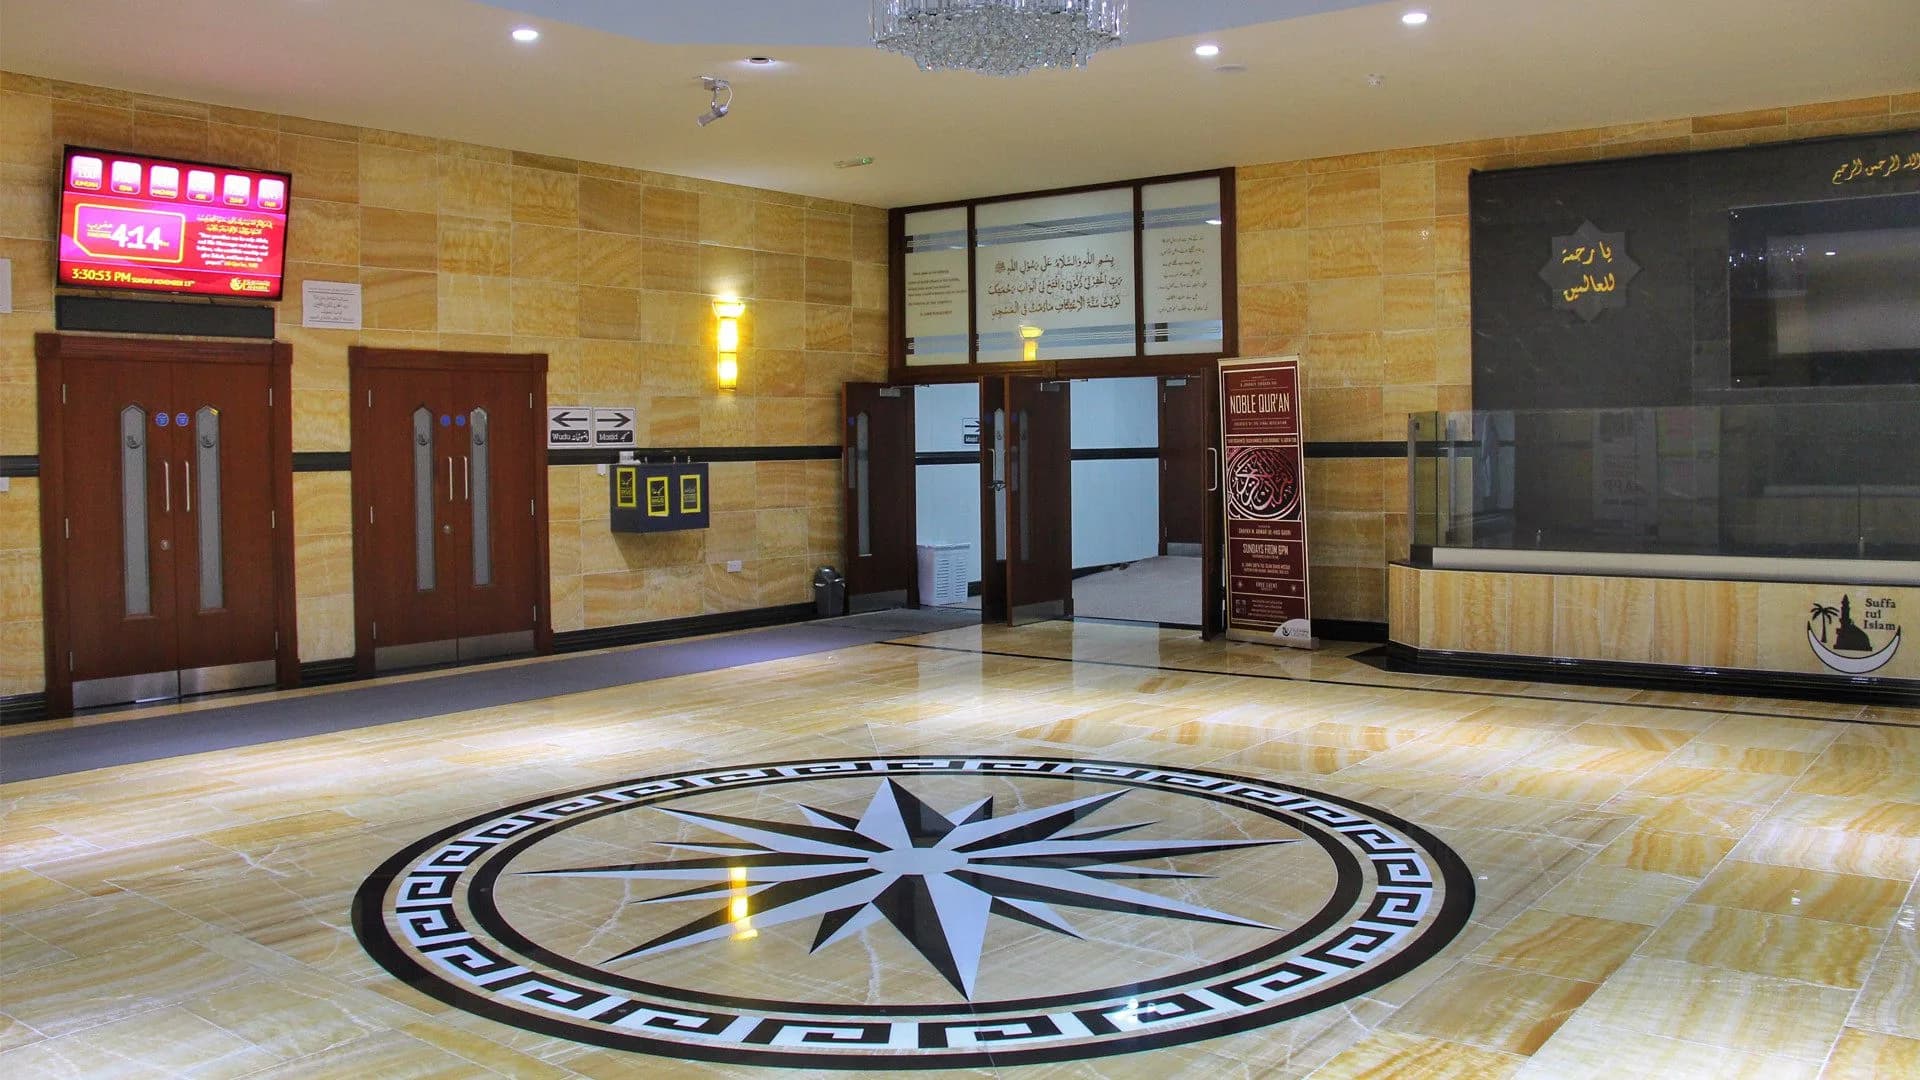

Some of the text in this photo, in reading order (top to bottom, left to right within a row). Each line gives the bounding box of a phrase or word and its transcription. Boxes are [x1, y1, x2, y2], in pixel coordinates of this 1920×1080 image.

[71, 268, 112, 281] 3:30:53
[114, 271, 131, 283] PM
[1230, 392, 1290, 414] NOBLE QUR'AN
[551, 432, 571, 441] Wudu
[1242, 543, 1264, 554] SUNDAYS
[1264, 544, 1278, 555] FROM
[1865, 598, 1896, 609] Suffa
[1865, 609, 1881, 619] tul
[1864, 619, 1896, 631] Islam
